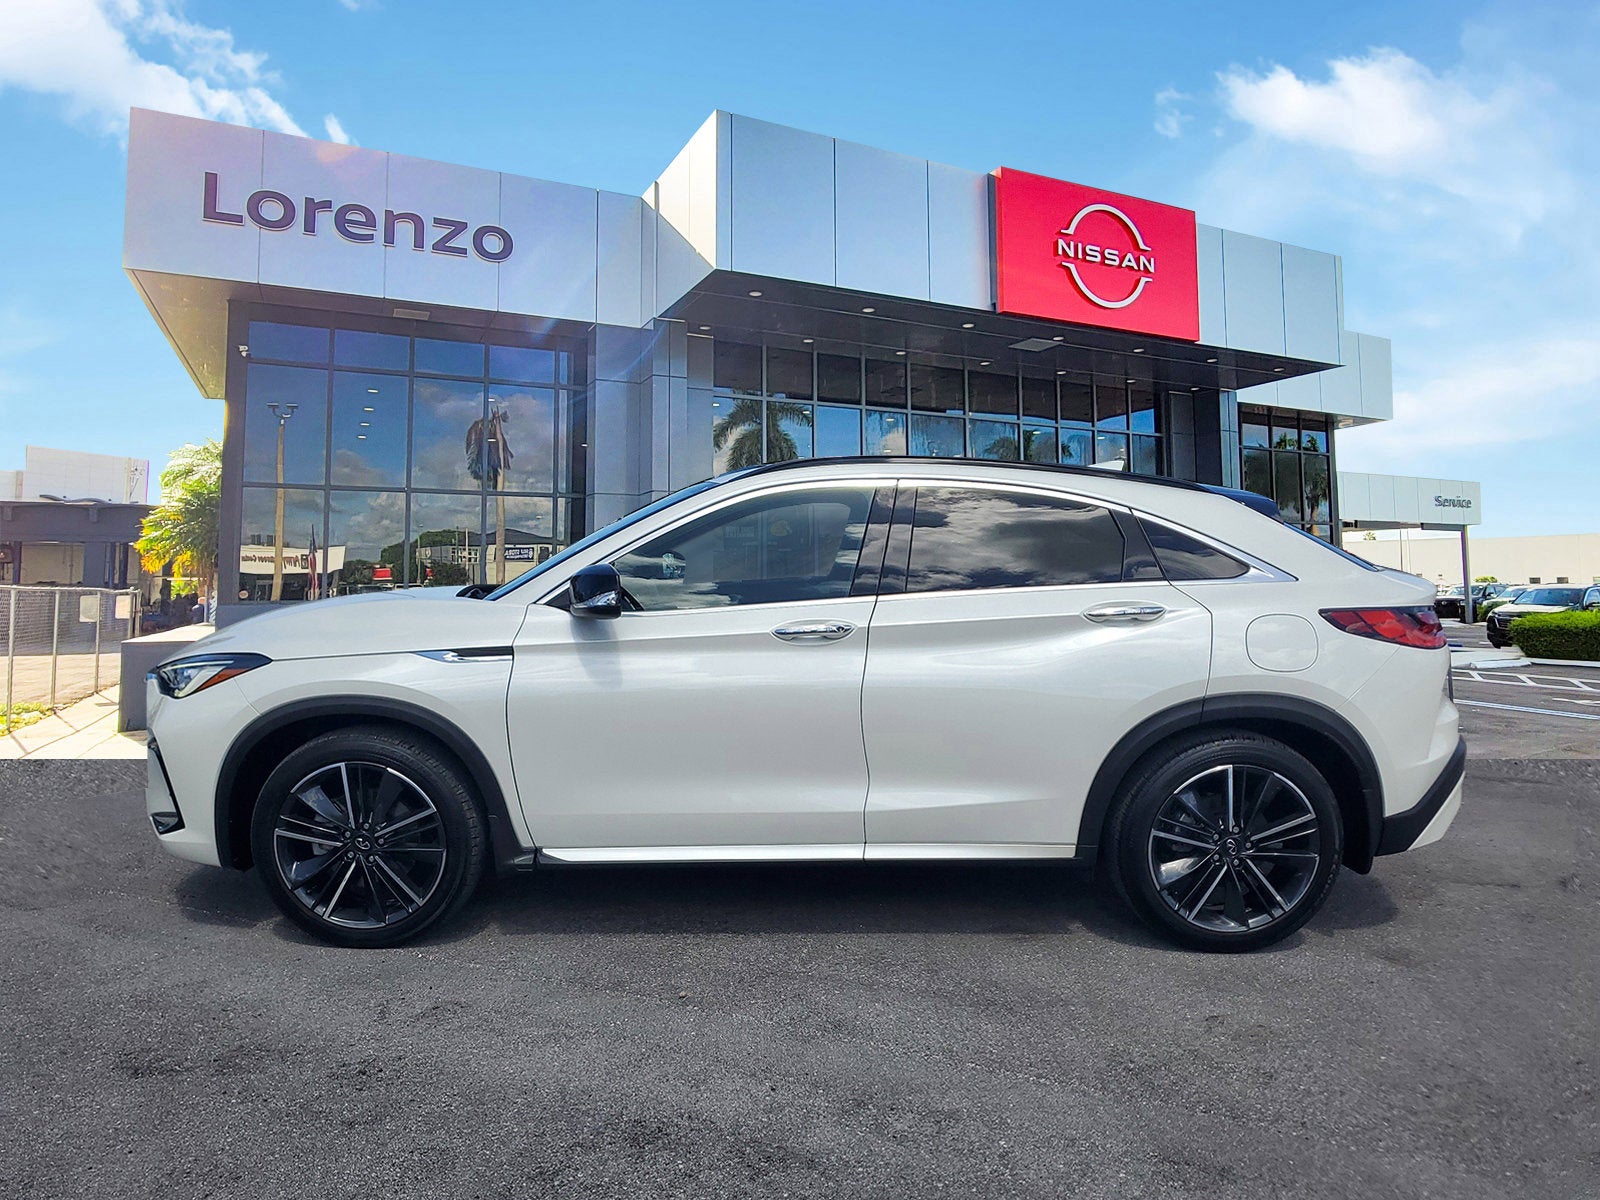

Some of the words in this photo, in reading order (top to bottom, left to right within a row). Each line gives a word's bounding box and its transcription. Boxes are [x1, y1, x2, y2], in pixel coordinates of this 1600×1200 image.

[202, 171, 514, 262] Lorenzo
[1057, 238, 1155, 273] NISSAN
[1434, 495, 1472, 509] Service
